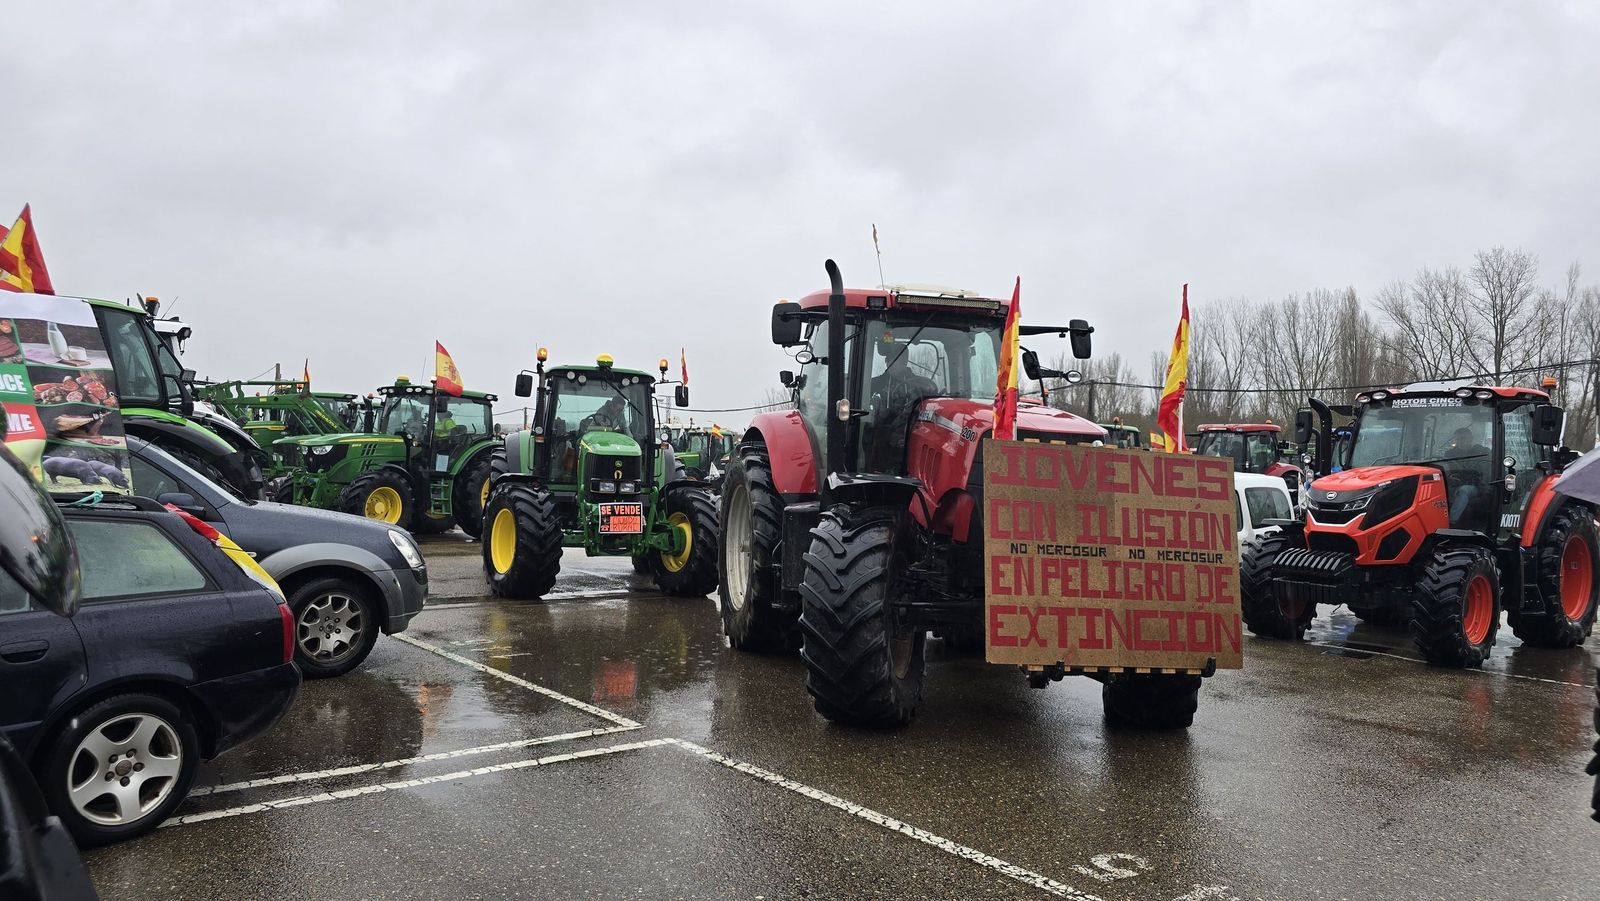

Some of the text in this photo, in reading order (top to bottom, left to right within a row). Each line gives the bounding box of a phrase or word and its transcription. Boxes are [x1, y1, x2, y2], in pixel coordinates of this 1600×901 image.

[991, 446, 1228, 500] JOVENES
[601, 505, 641, 515] SE VENDE
[991, 499, 1231, 551] CON ILUSIÓN
[1500, 513, 1520, 527] KIOTI
[1010, 543, 1223, 564] NO MERCOSUR NO MERCOSUR
[991, 556, 1234, 604] EN PELIGRO DE
